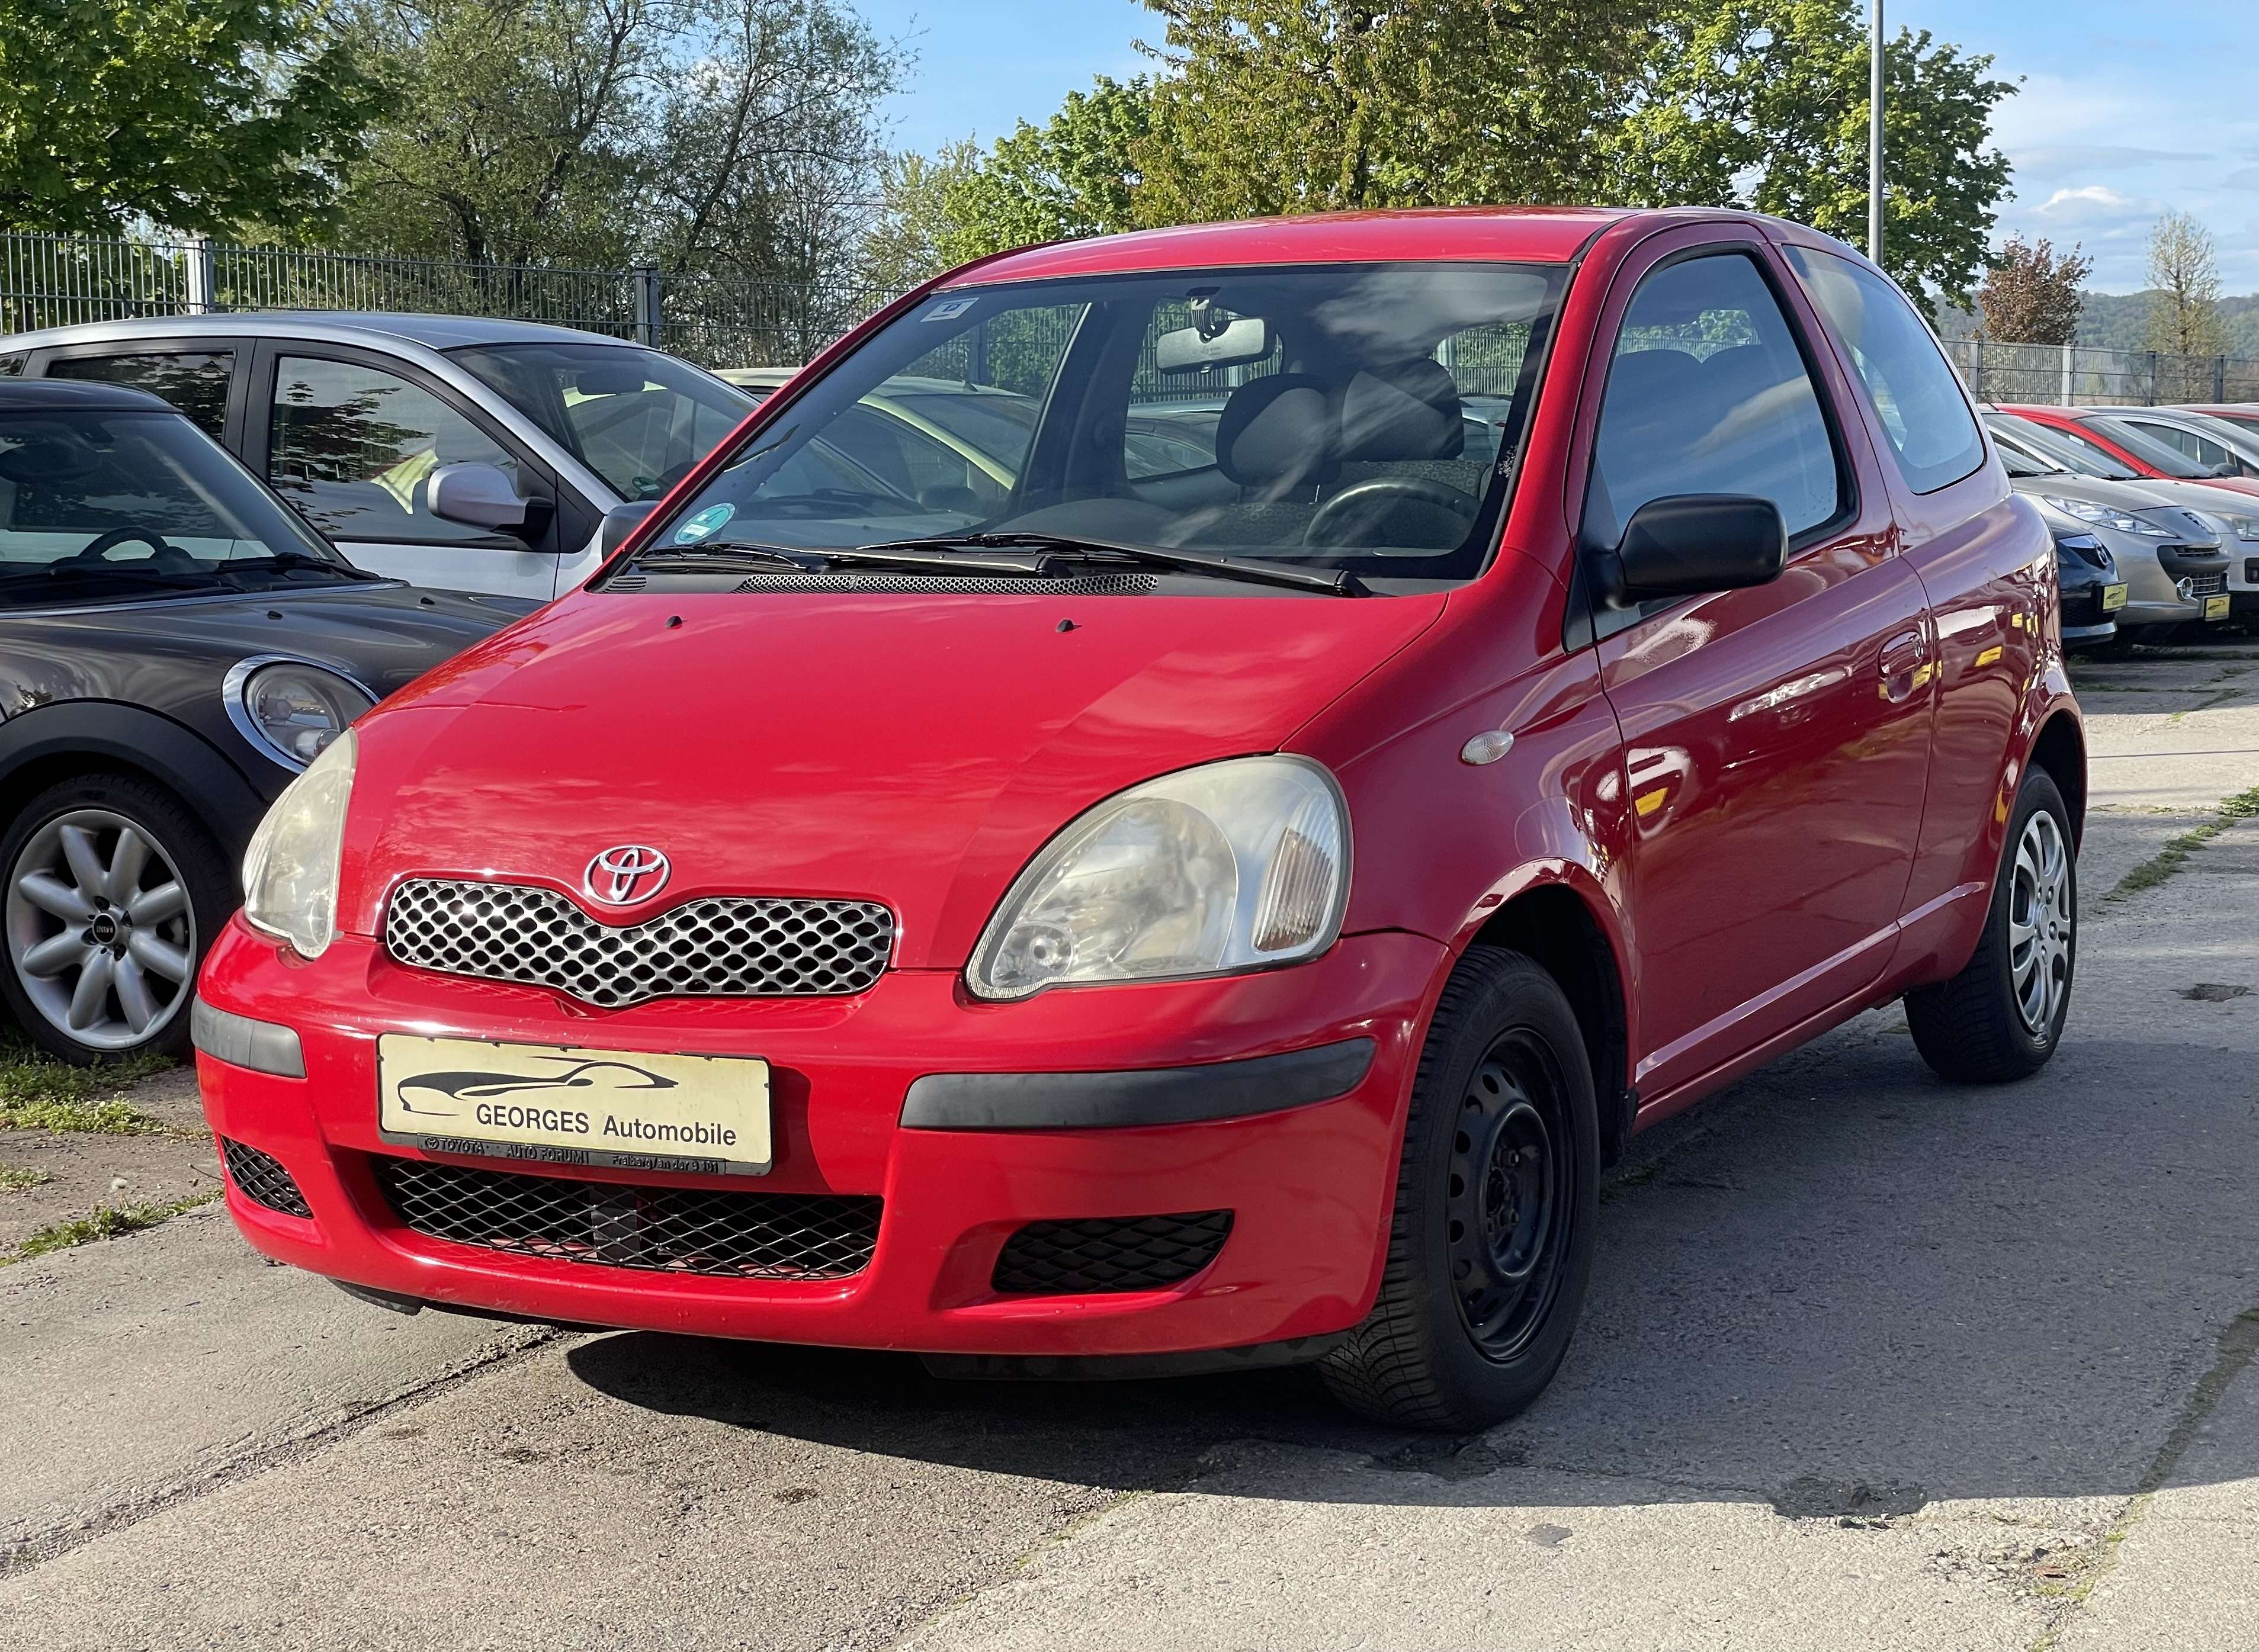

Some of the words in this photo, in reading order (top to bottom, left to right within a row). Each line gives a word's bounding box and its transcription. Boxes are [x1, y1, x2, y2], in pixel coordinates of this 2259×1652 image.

[476, 1104, 589, 1134] GEORGES
[603, 1115, 736, 1146] Automobile
[439, 1138, 485, 1154] TOYOTA
[507, 1144, 537, 1159] AUTO
